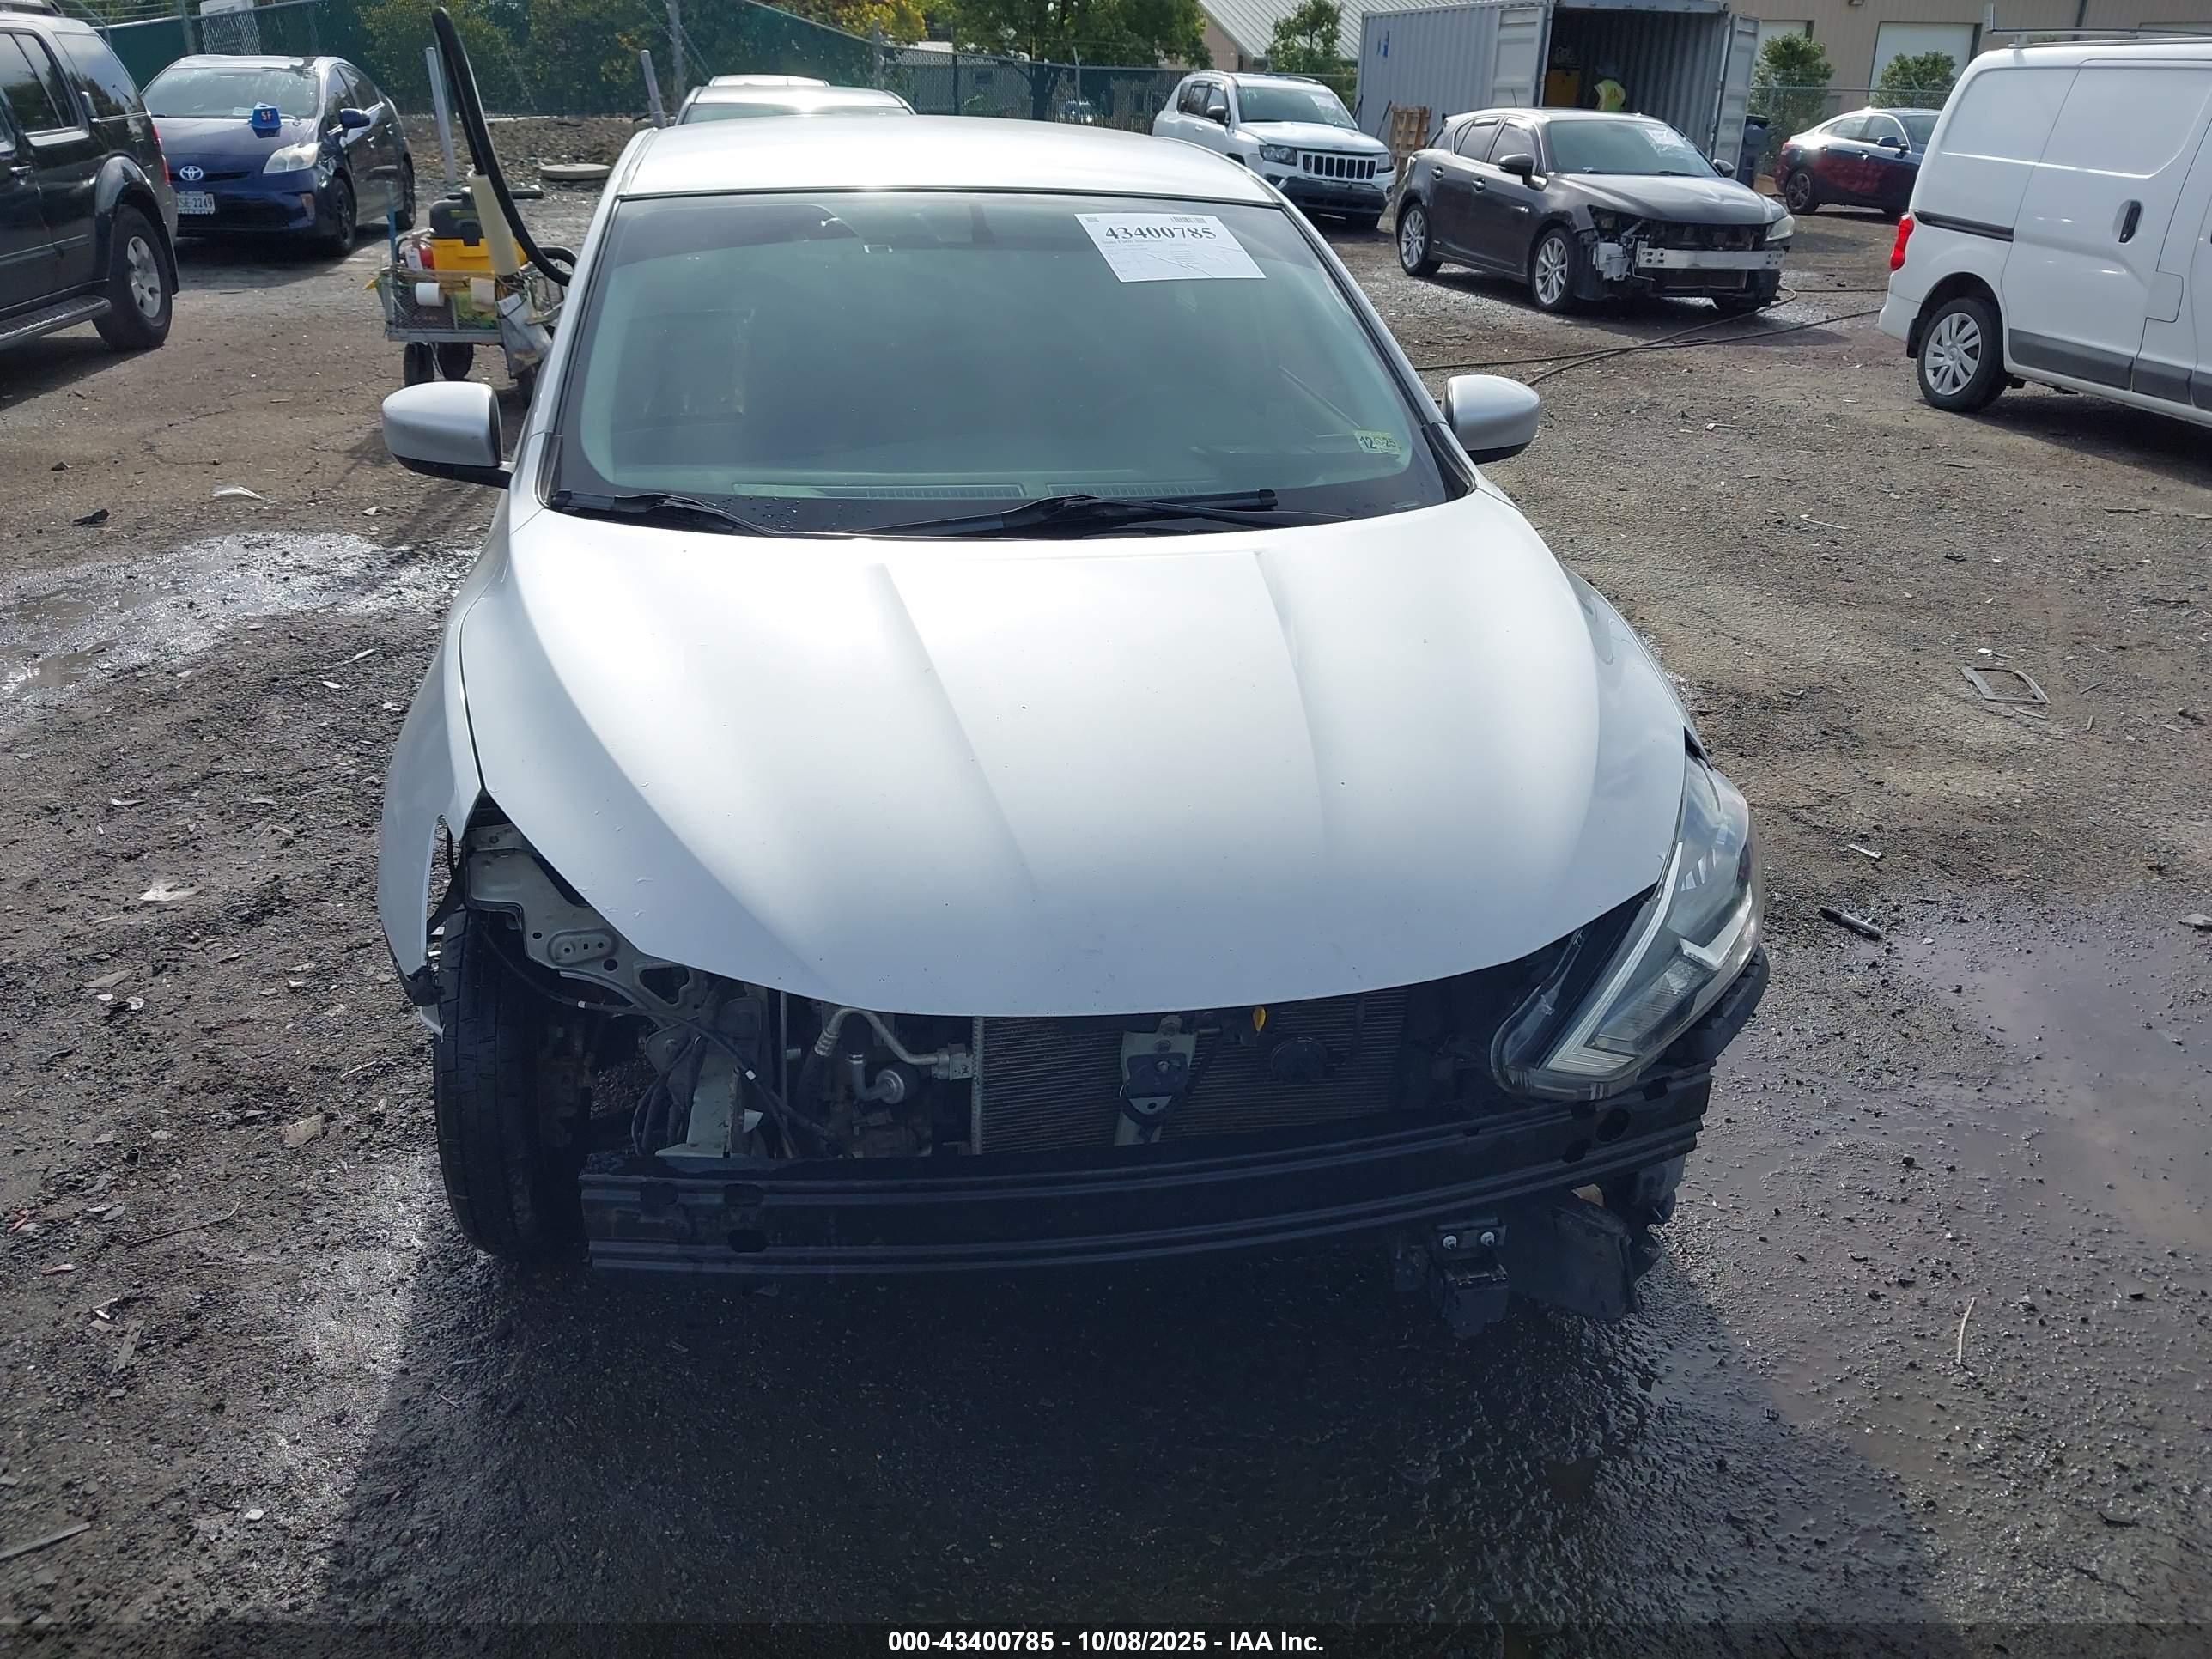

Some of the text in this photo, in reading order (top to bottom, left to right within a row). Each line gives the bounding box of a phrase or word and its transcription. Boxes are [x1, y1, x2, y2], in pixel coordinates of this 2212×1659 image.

[261, 111, 272, 121] SF
[1105, 226, 1217, 240] 43400785
[1360, 436, 1396, 449] 12 25
